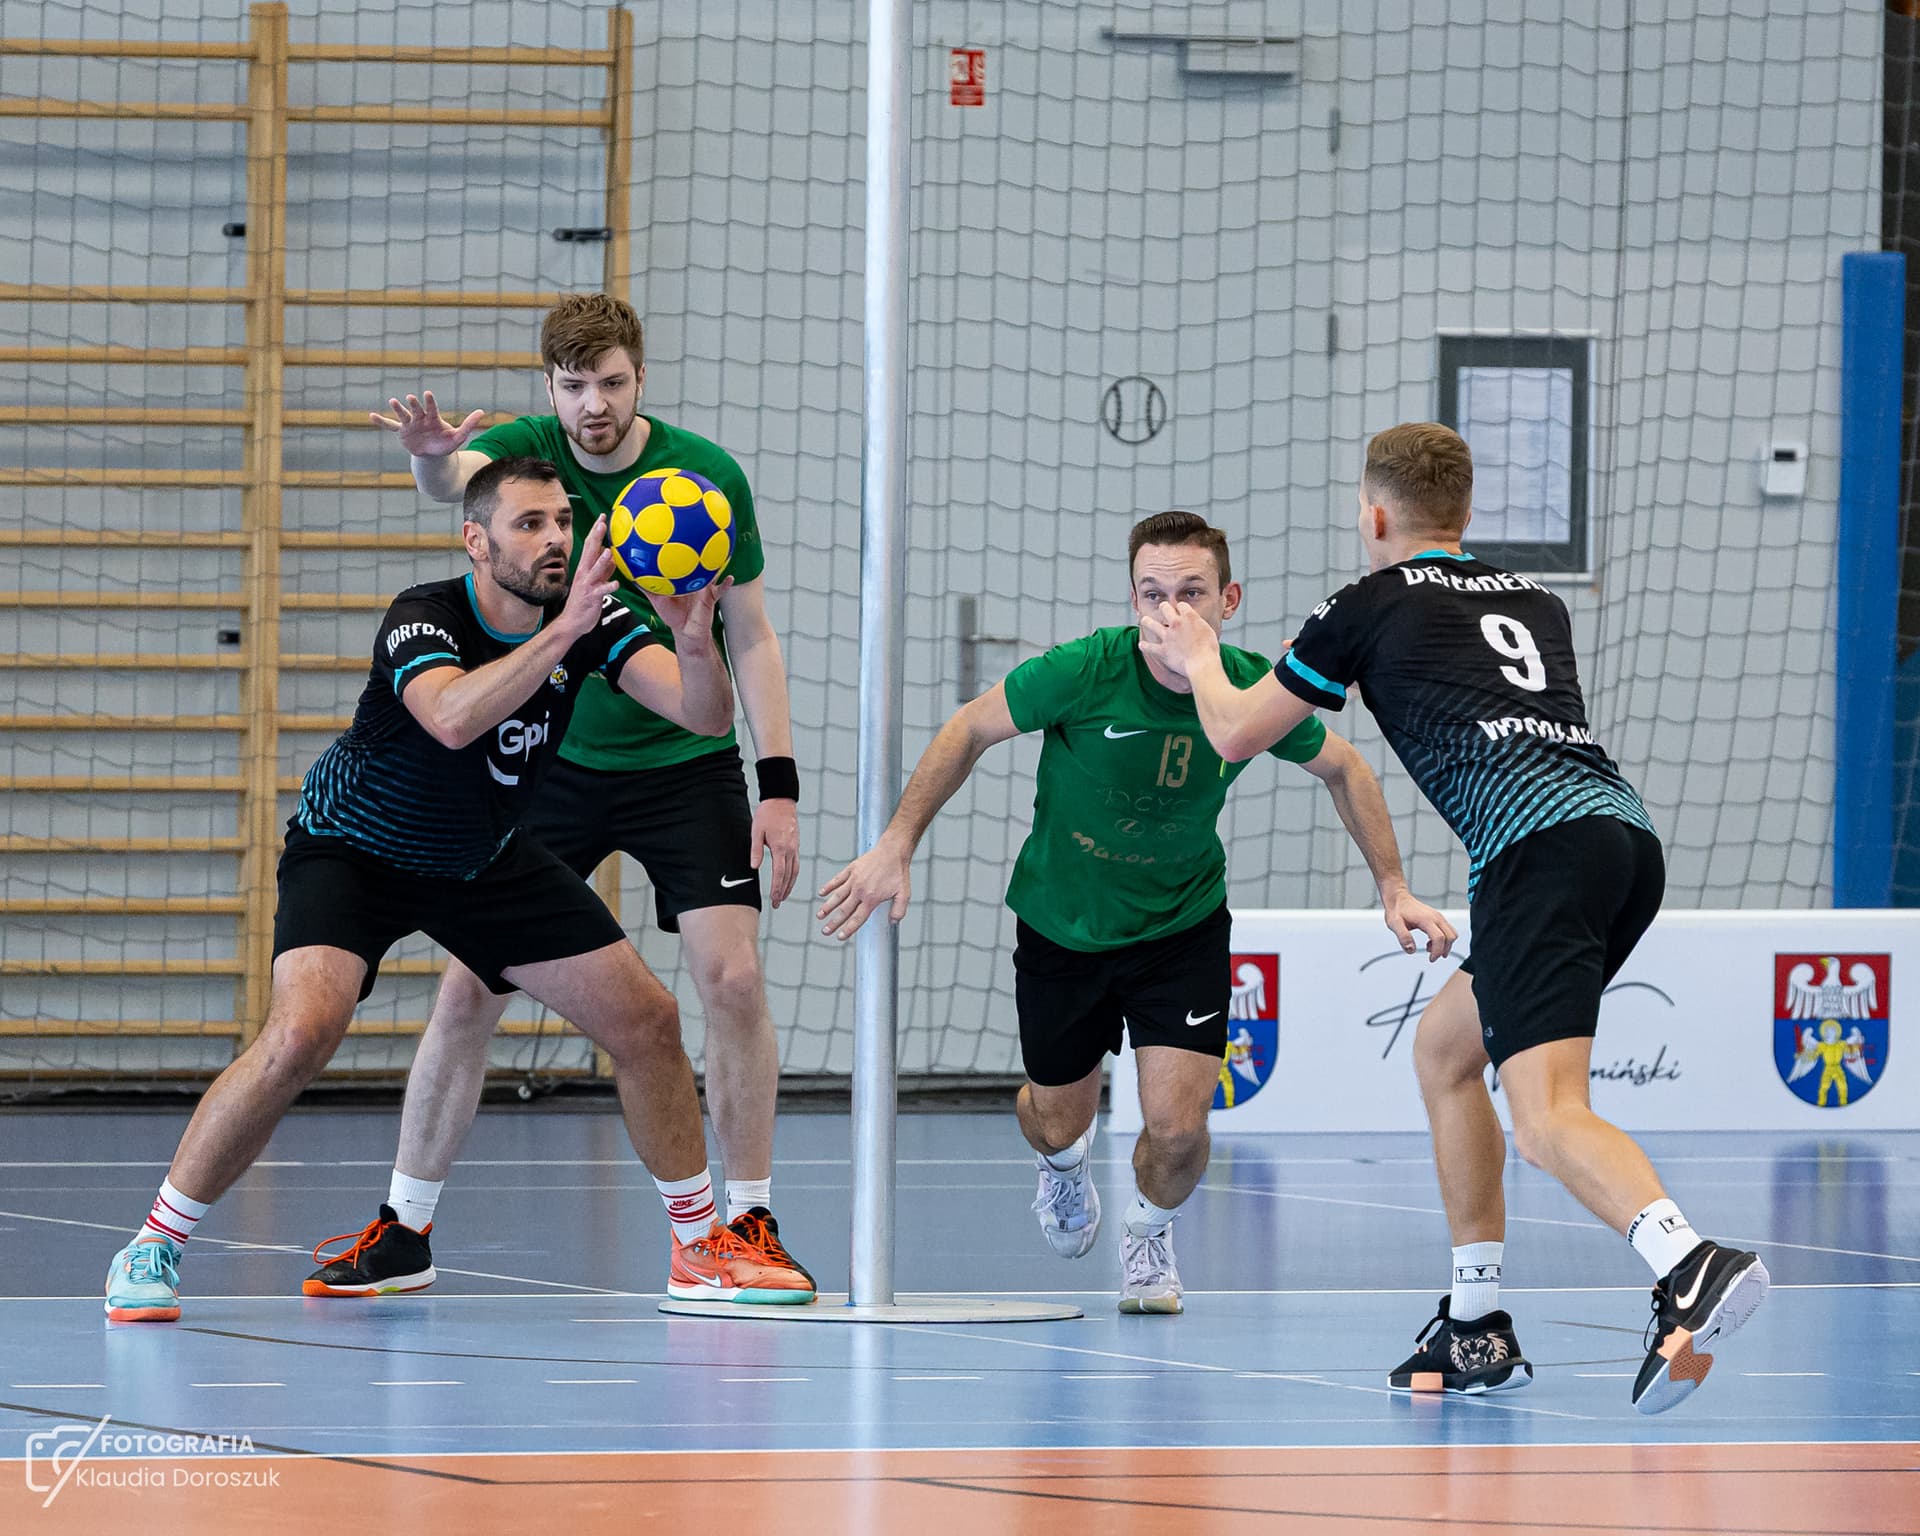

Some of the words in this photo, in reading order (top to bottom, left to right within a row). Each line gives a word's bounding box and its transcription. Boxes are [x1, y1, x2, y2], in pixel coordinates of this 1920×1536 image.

[1480, 613, 1547, 692] 9
[498, 710, 550, 763] Gpi
[1155, 734, 1193, 788] 13
